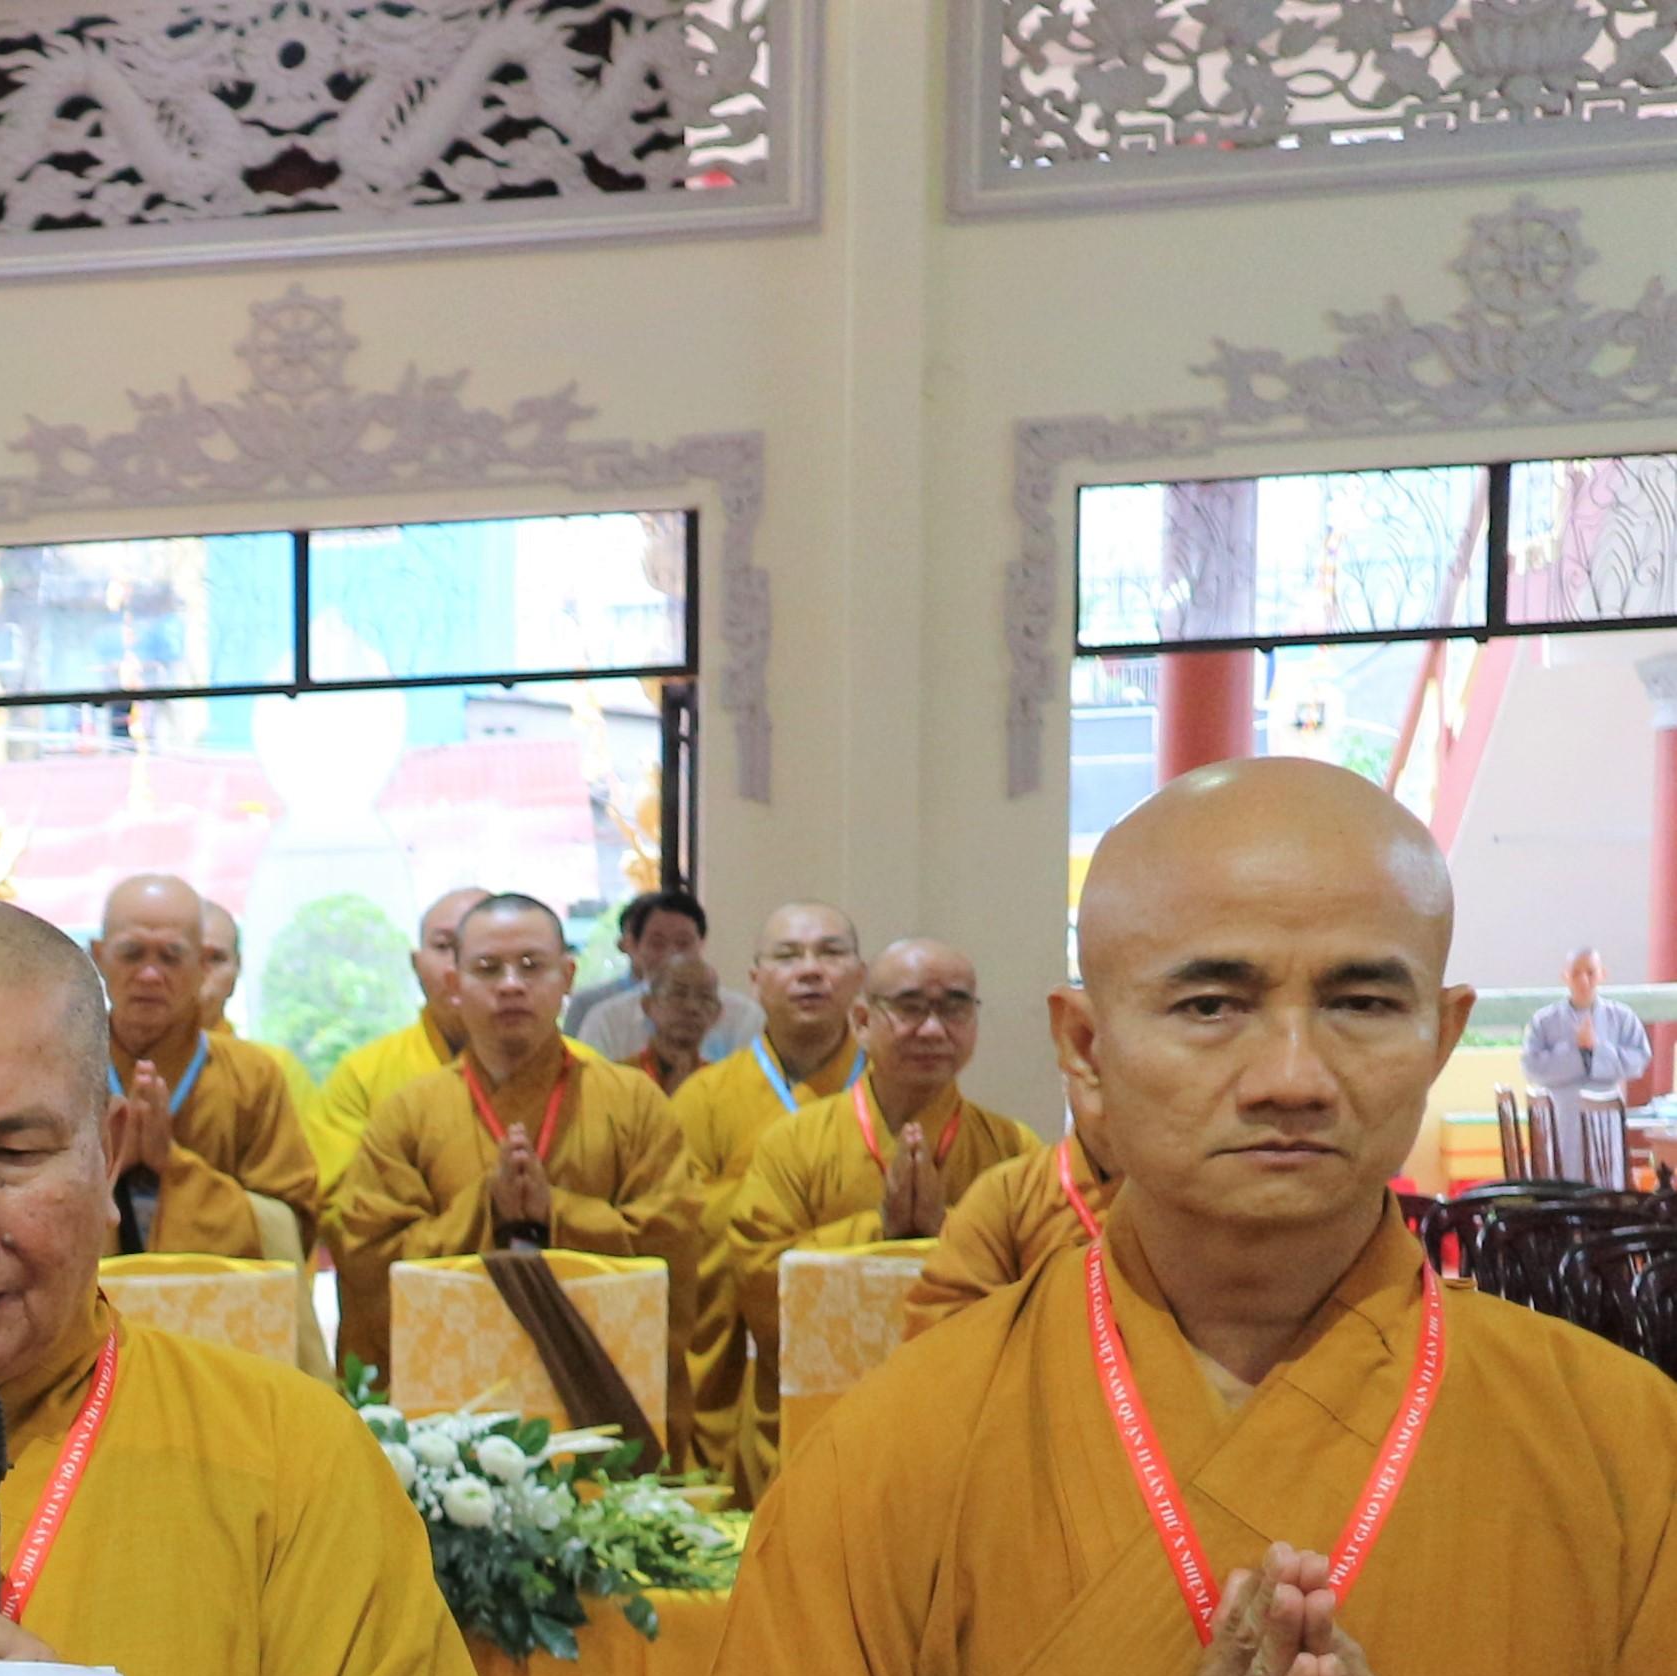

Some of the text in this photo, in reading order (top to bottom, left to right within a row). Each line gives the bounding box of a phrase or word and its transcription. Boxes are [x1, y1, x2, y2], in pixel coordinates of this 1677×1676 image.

[1094, 1330, 1116, 1364] VIỆT
[1104, 1366, 1128, 1401] NAM
[80, 1397, 101, 1429] VIỆT
[1114, 1400, 1146, 1448] QUẬN
[67, 1430, 90, 1463] NAM
[47, 1460, 75, 1502] QUẬN
[1142, 1463, 1168, 1498] LẦN
[1328, 1541, 1363, 1587] PHẬT
[1350, 1500, 1382, 1544] GIÁO
[1372, 1462, 1400, 1502] VIỆT
[1389, 1427, 1415, 1463] NAM
[1403, 1384, 1432, 1428] QUẬN
[30, 1516, 52, 1546] LẦN
[1156, 1498, 1182, 1532] THỨ
[17, 1545, 41, 1578] THỨ
[1174, 1549, 1209, 1606] NHIỆM
